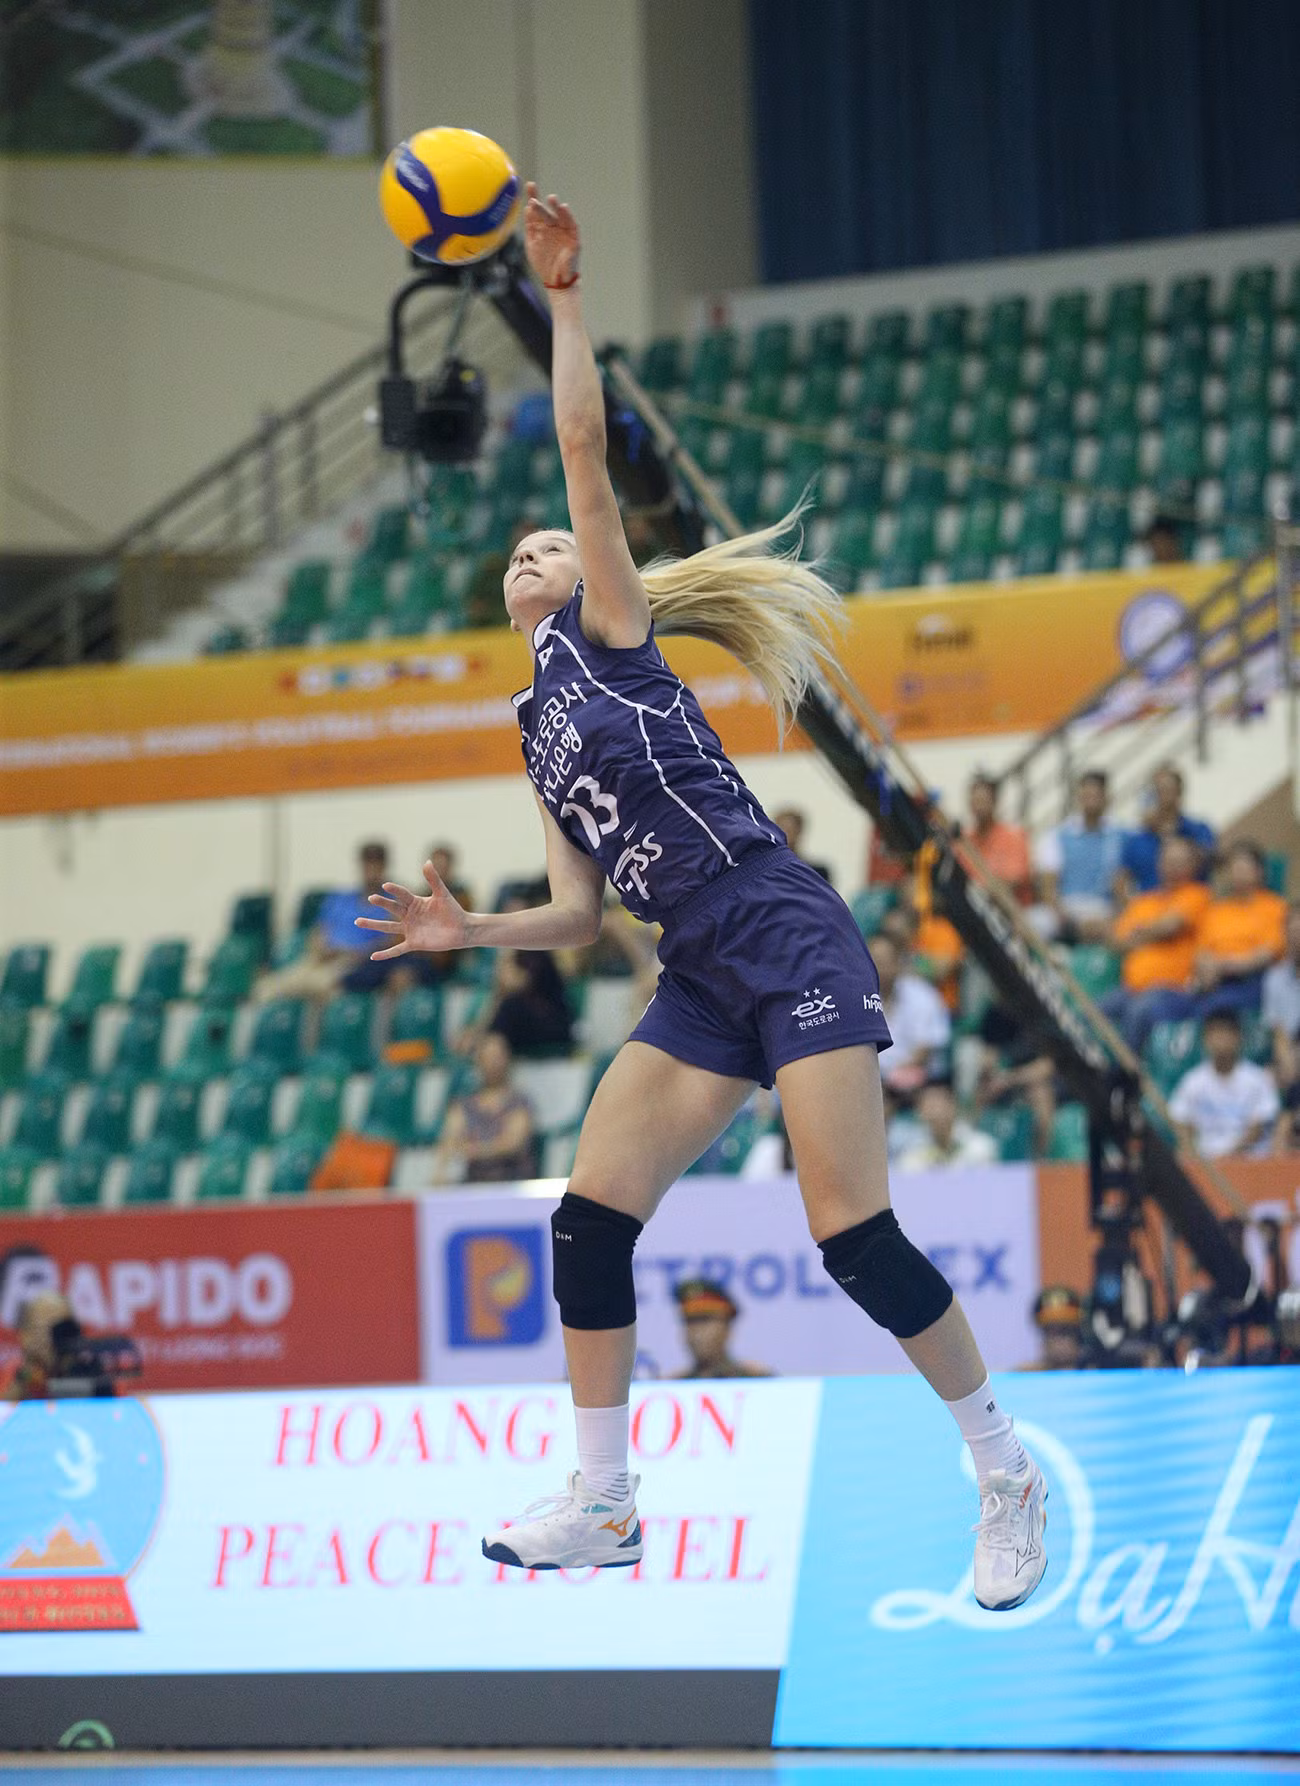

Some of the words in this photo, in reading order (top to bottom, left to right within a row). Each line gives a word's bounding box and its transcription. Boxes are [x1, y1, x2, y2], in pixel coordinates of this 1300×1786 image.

[791, 995, 836, 1018] ex
[798, 1011, 840, 1031] 한국도로공사
[0, 1252, 293, 1330] RAPIDO
[270, 1397, 557, 1467] HOANG
[629, 1390, 747, 1458] ON
[210, 1518, 468, 1588] PEACE
[493, 1517, 770, 1586] TEL
